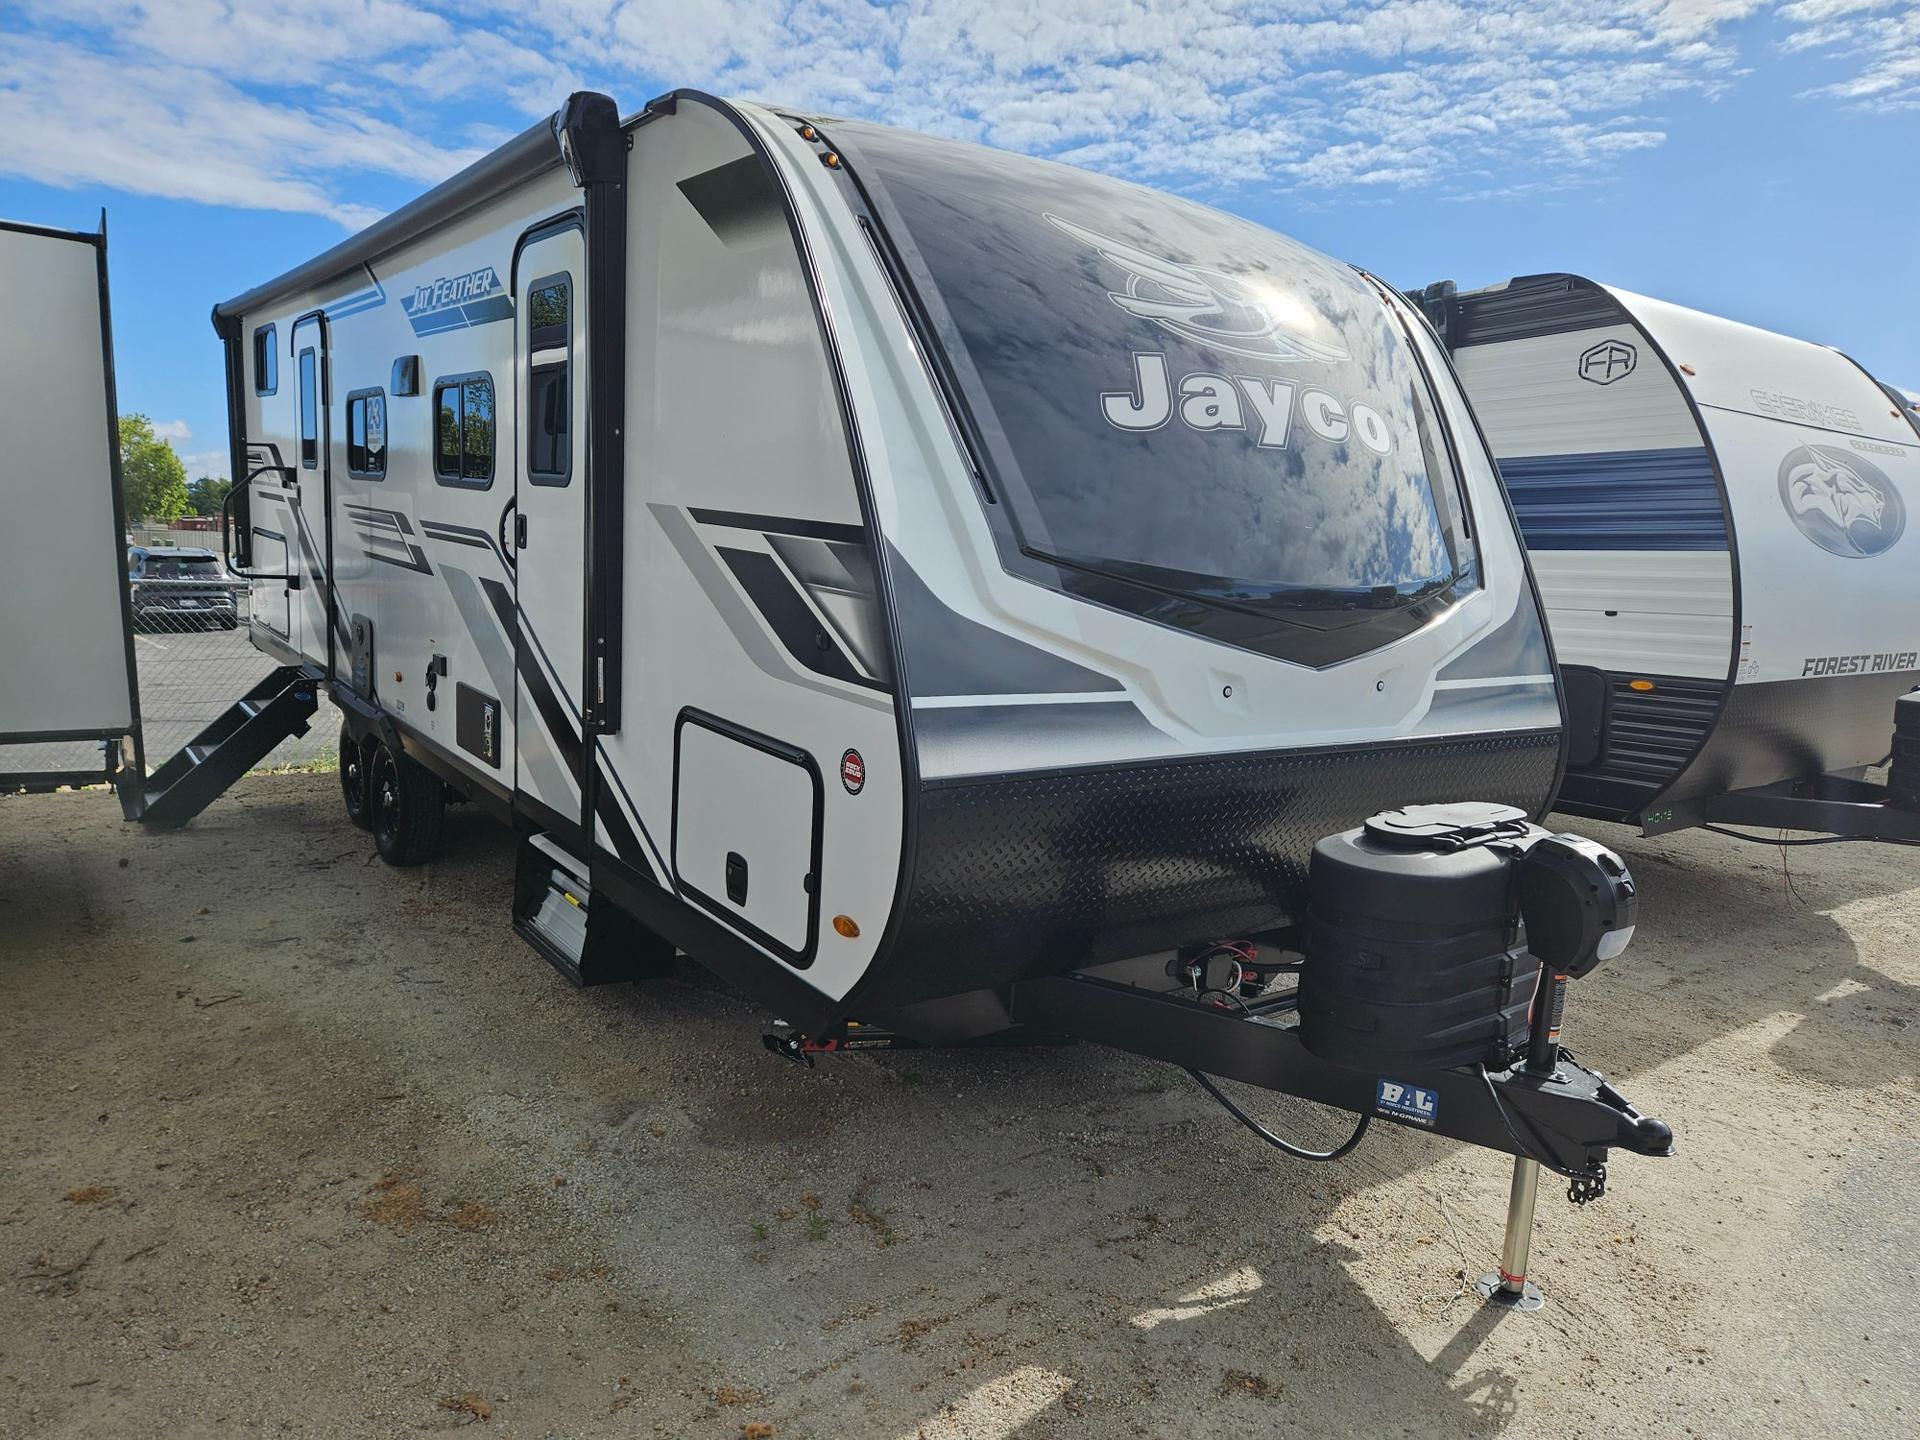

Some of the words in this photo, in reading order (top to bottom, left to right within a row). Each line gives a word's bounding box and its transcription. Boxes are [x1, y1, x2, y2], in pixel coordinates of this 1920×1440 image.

[408, 286, 433, 313] JAY
[431, 268, 493, 307] FEATHER
[1100, 350, 1393, 457] Jayco
[1801, 654, 1871, 677] FOREST
[1870, 651, 1918, 672] RIVER
